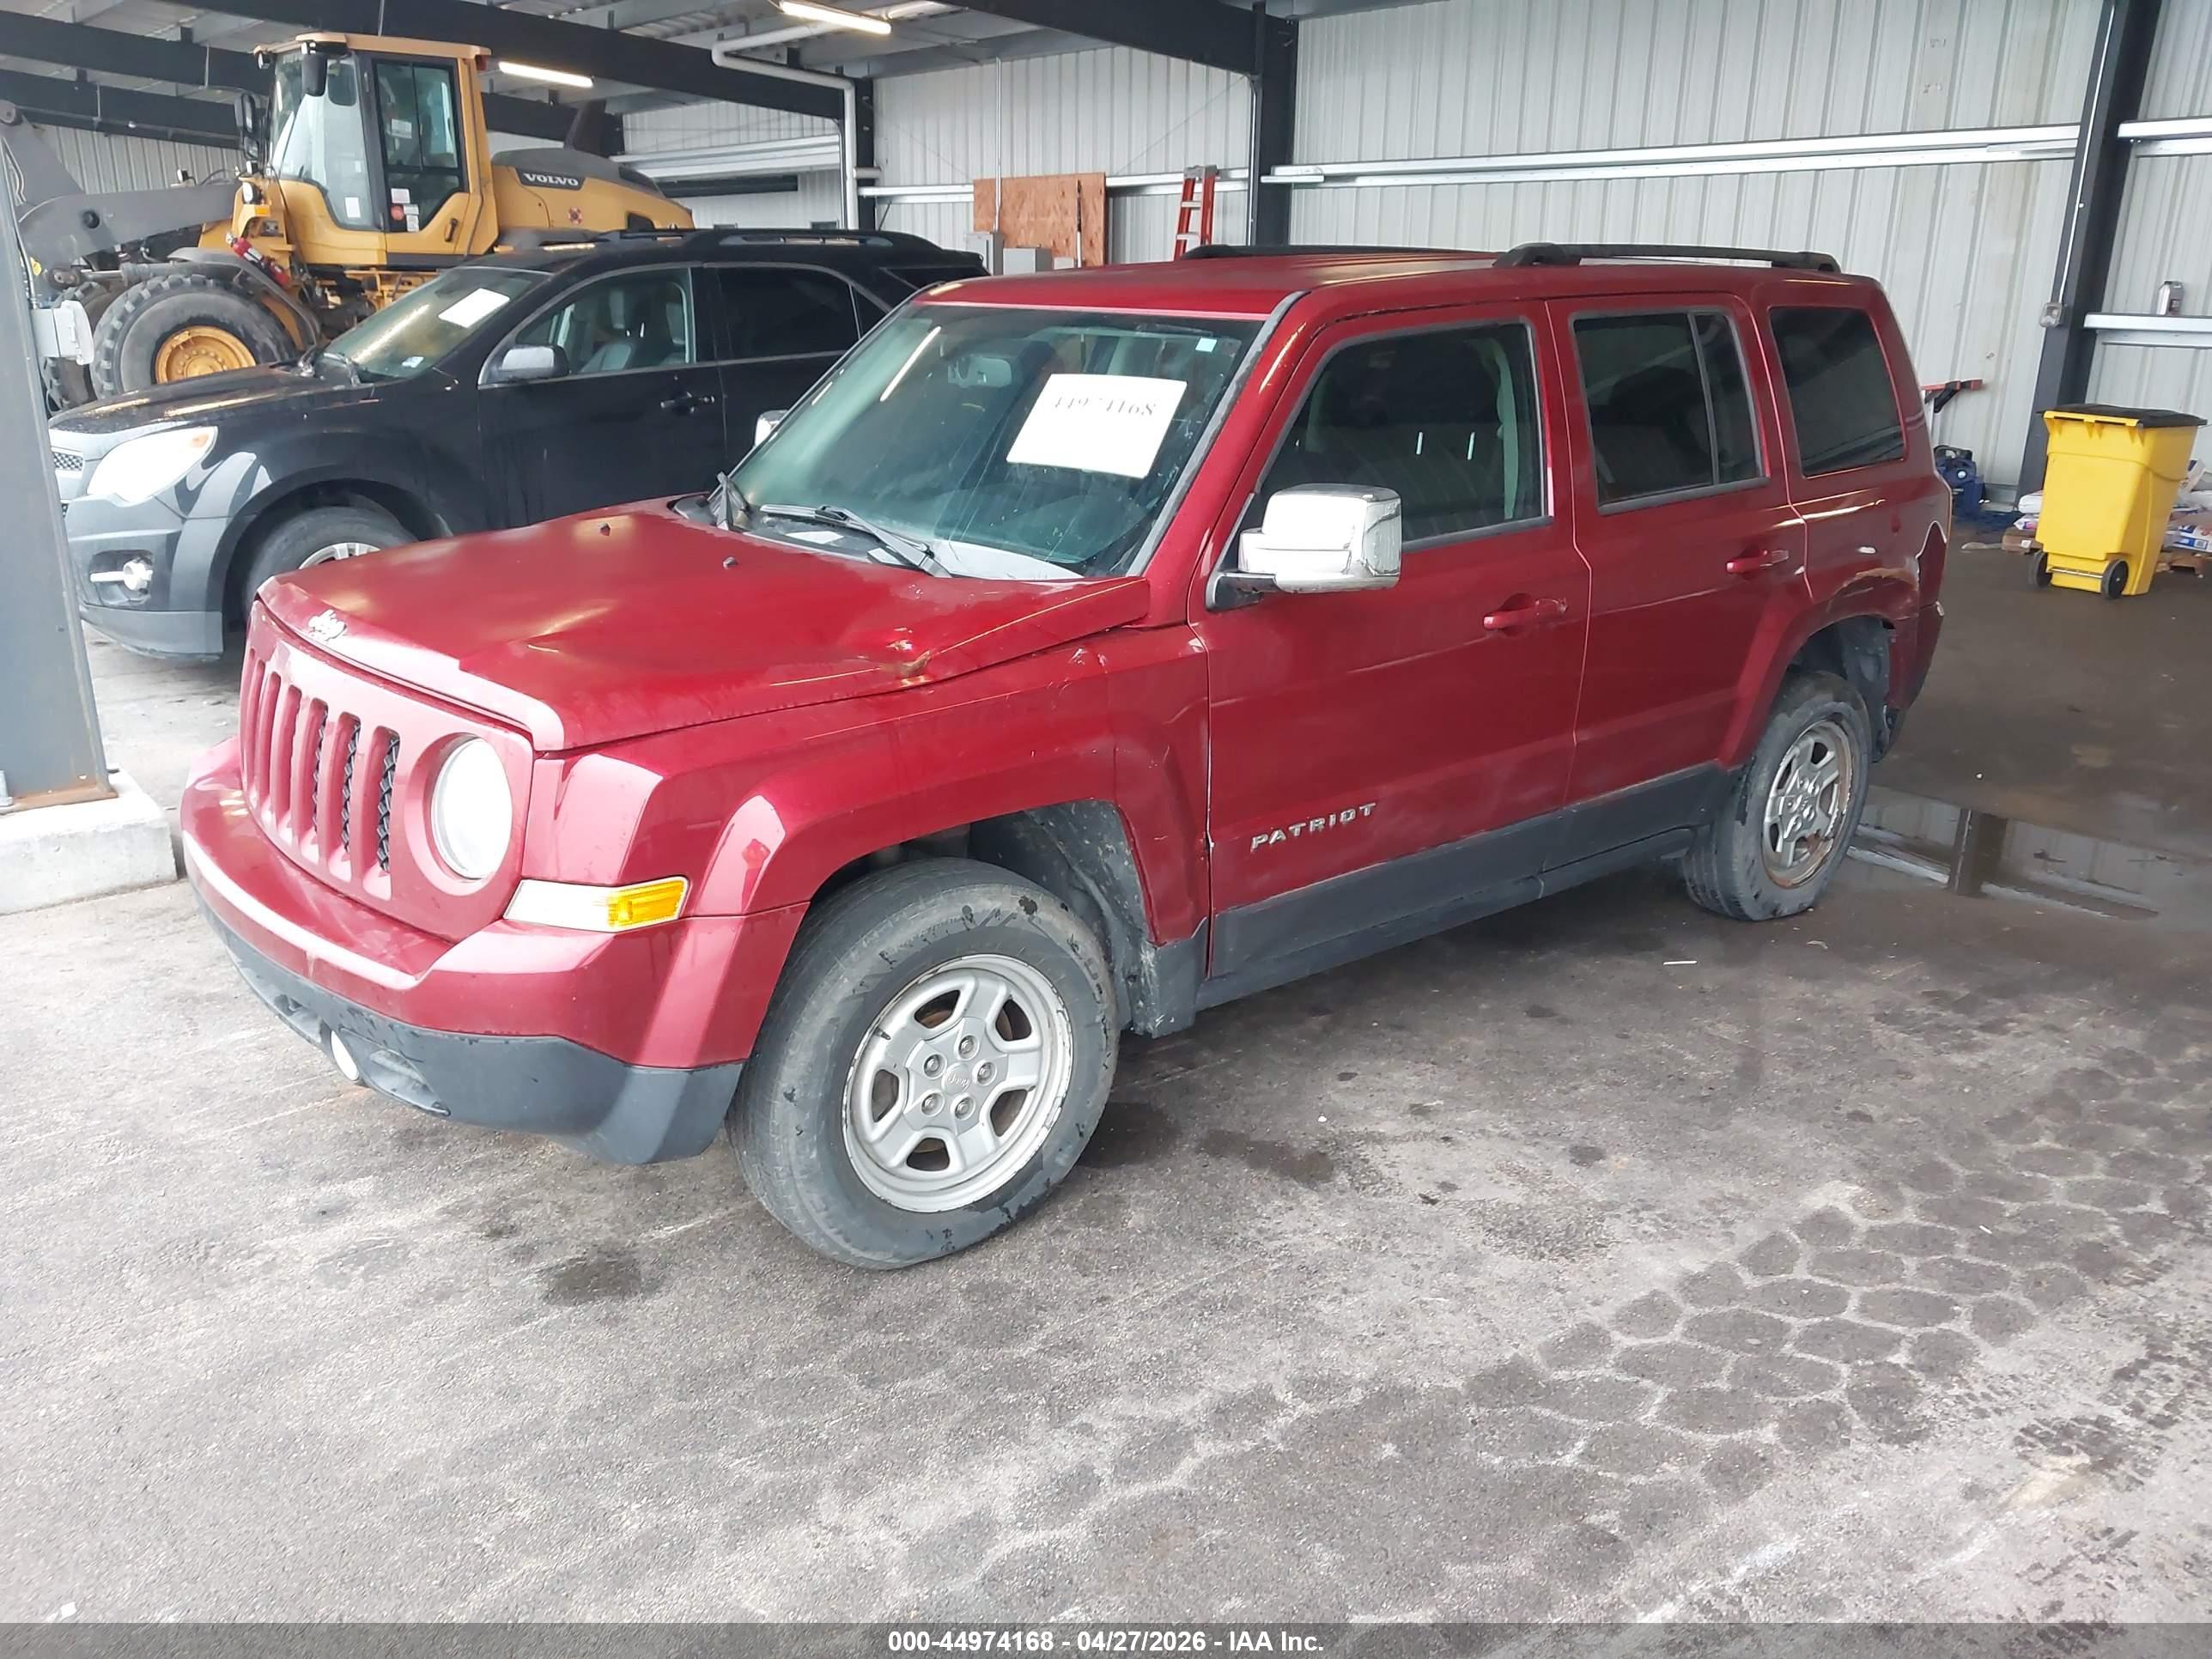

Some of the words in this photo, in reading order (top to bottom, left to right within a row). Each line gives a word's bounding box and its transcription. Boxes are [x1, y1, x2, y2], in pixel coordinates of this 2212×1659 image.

[523, 173, 579, 186] VOLVO
[1054, 396, 1158, 416] 4494168
[1250, 802, 1376, 851] PATRIOT
